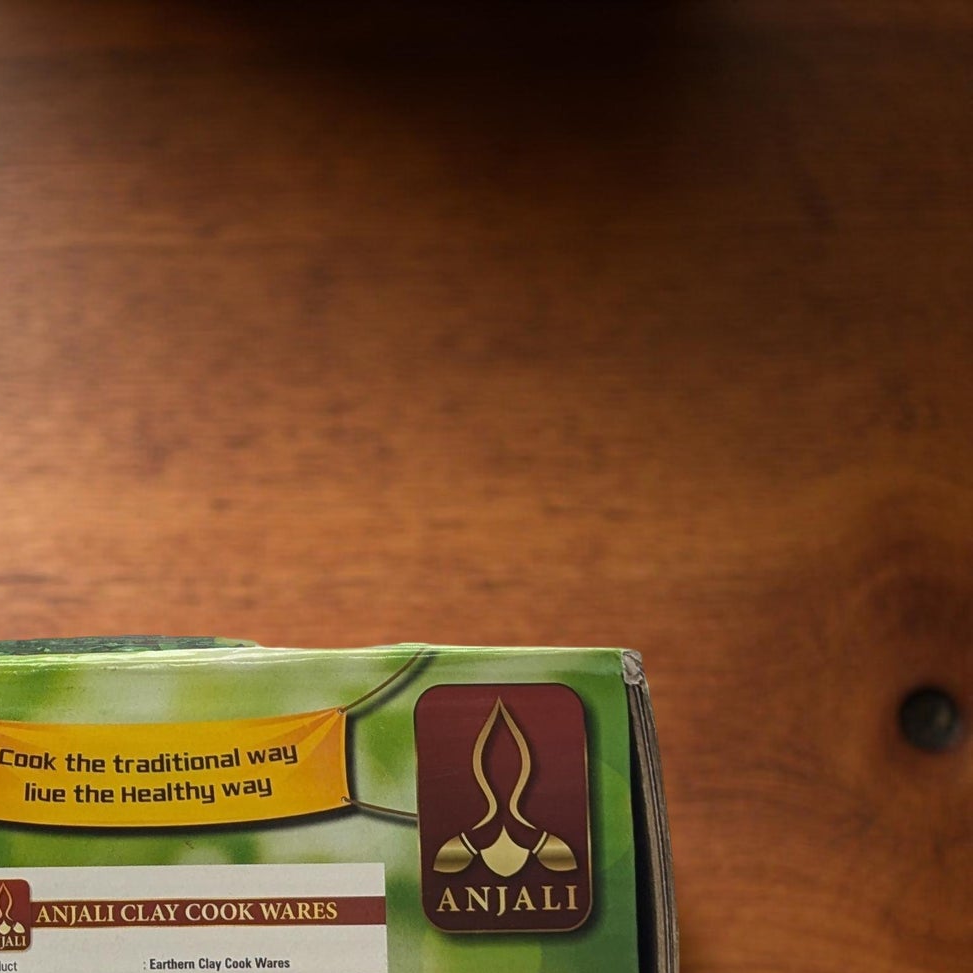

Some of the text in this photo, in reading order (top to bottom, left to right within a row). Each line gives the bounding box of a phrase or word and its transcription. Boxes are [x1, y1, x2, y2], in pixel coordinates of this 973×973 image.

[65, 753, 106, 773] the
[113, 748, 241, 773] traditional
[247, 744, 298, 765] way
[73, 783, 114, 803] the
[121, 781, 215, 804] Healthy
[221, 777, 272, 798] way
[35, 902, 338, 925] ANJALI CLAY COOK WARES
[437, 885, 580, 917] ANJALI
[150, 958, 195, 969] Earthern
[199, 958, 221, 971] Clay
[225, 958, 251, 969] Cook
[255, 958, 290, 968] Wares
